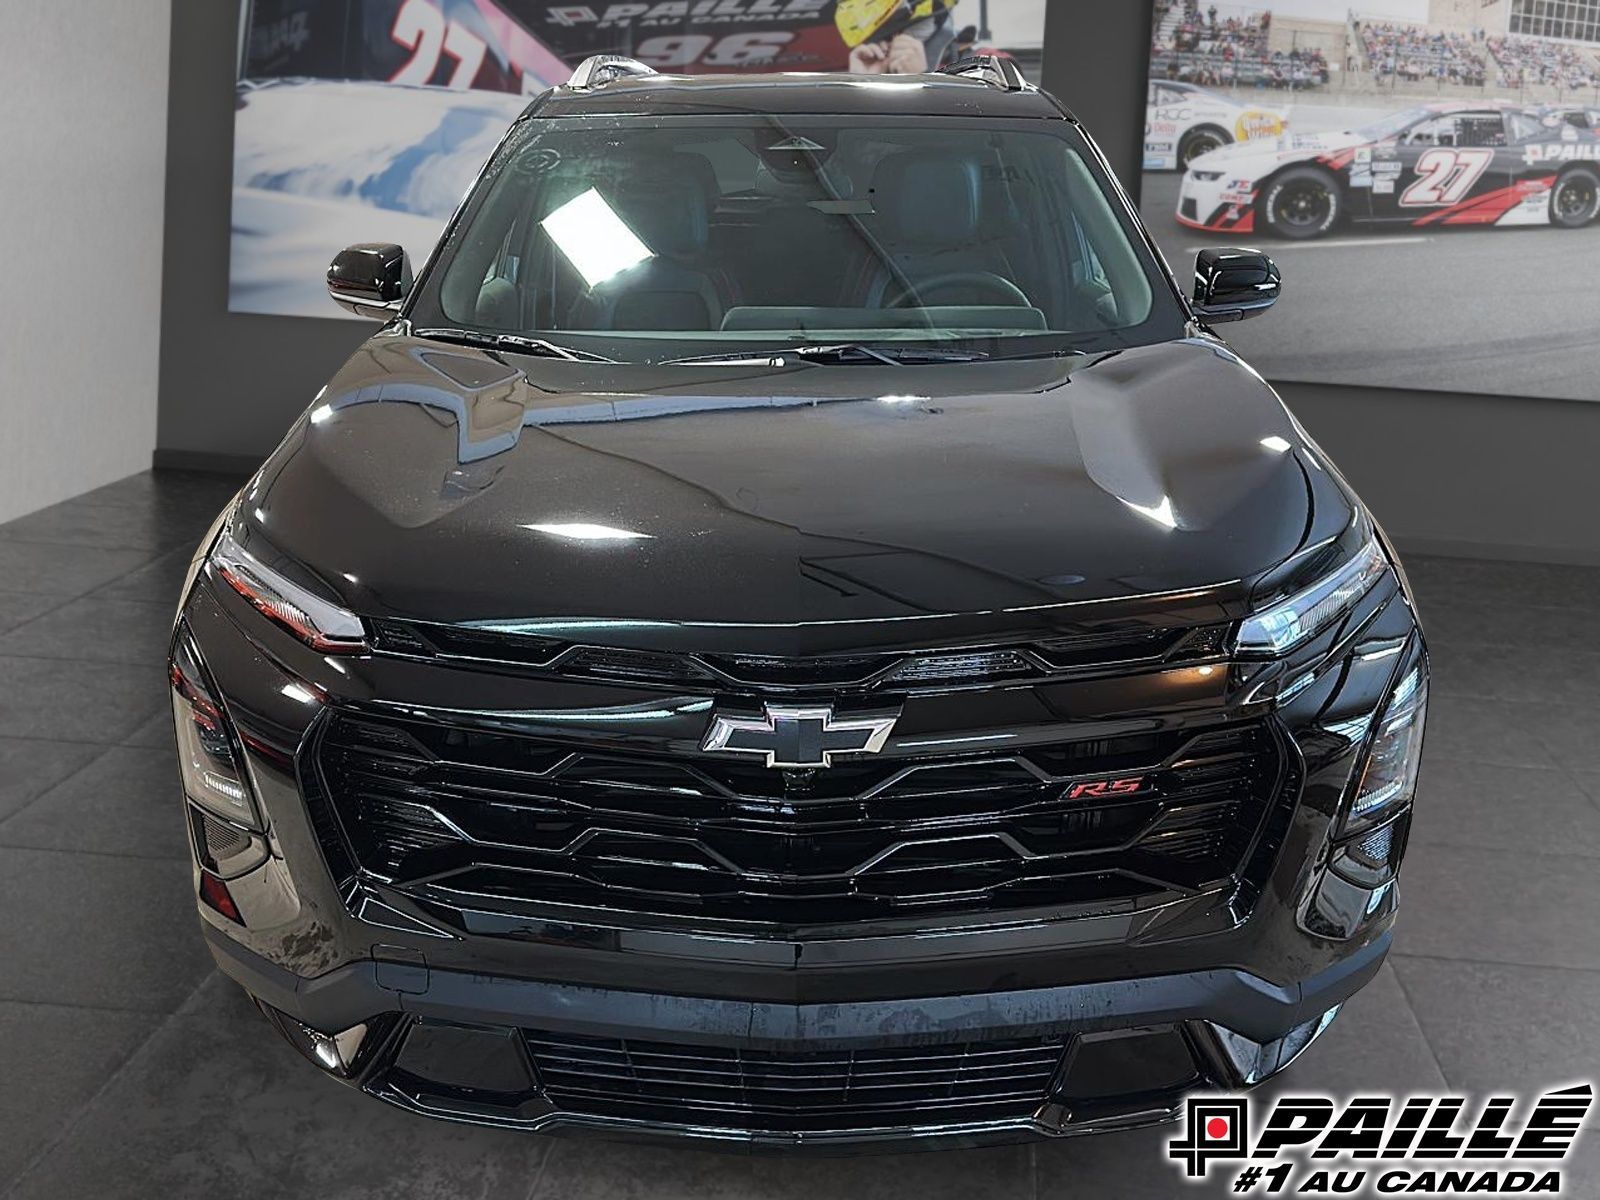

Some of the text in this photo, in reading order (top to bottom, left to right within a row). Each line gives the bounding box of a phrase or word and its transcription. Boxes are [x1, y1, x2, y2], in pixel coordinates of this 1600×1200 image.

[640, 18, 681, 27] AU
[692, 11, 819, 25] CANADA
[387, 0, 488, 89] 27
[637, 31, 794, 67] 96
[1399, 148, 1494, 207] 27
[1069, 777, 1143, 799] RS
